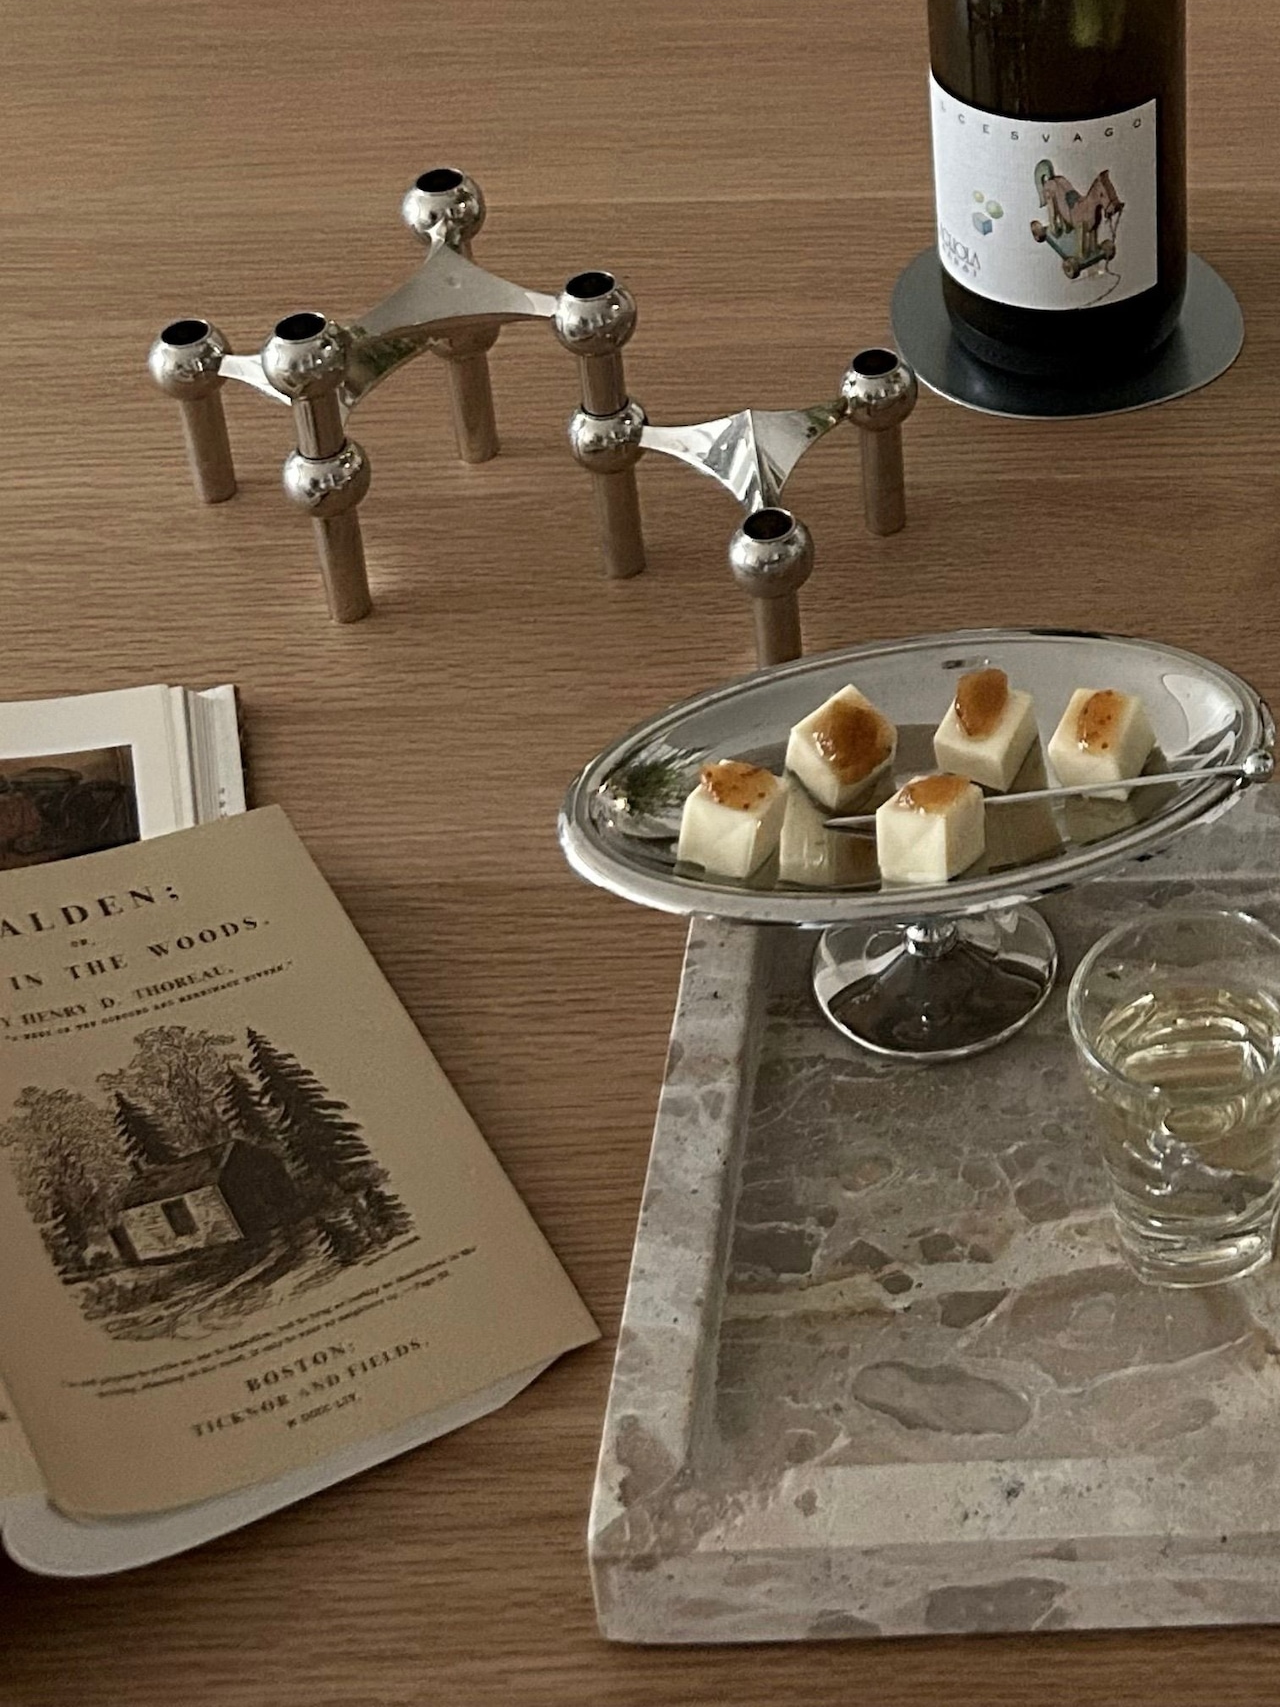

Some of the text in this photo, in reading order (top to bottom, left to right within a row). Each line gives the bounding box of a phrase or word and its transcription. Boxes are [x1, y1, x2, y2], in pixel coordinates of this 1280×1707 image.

[0, 886, 179, 938] ALDEN;
[9, 916, 270, 991] IN THE WOODS.
[22, 1003, 87, 1026] HENRY
